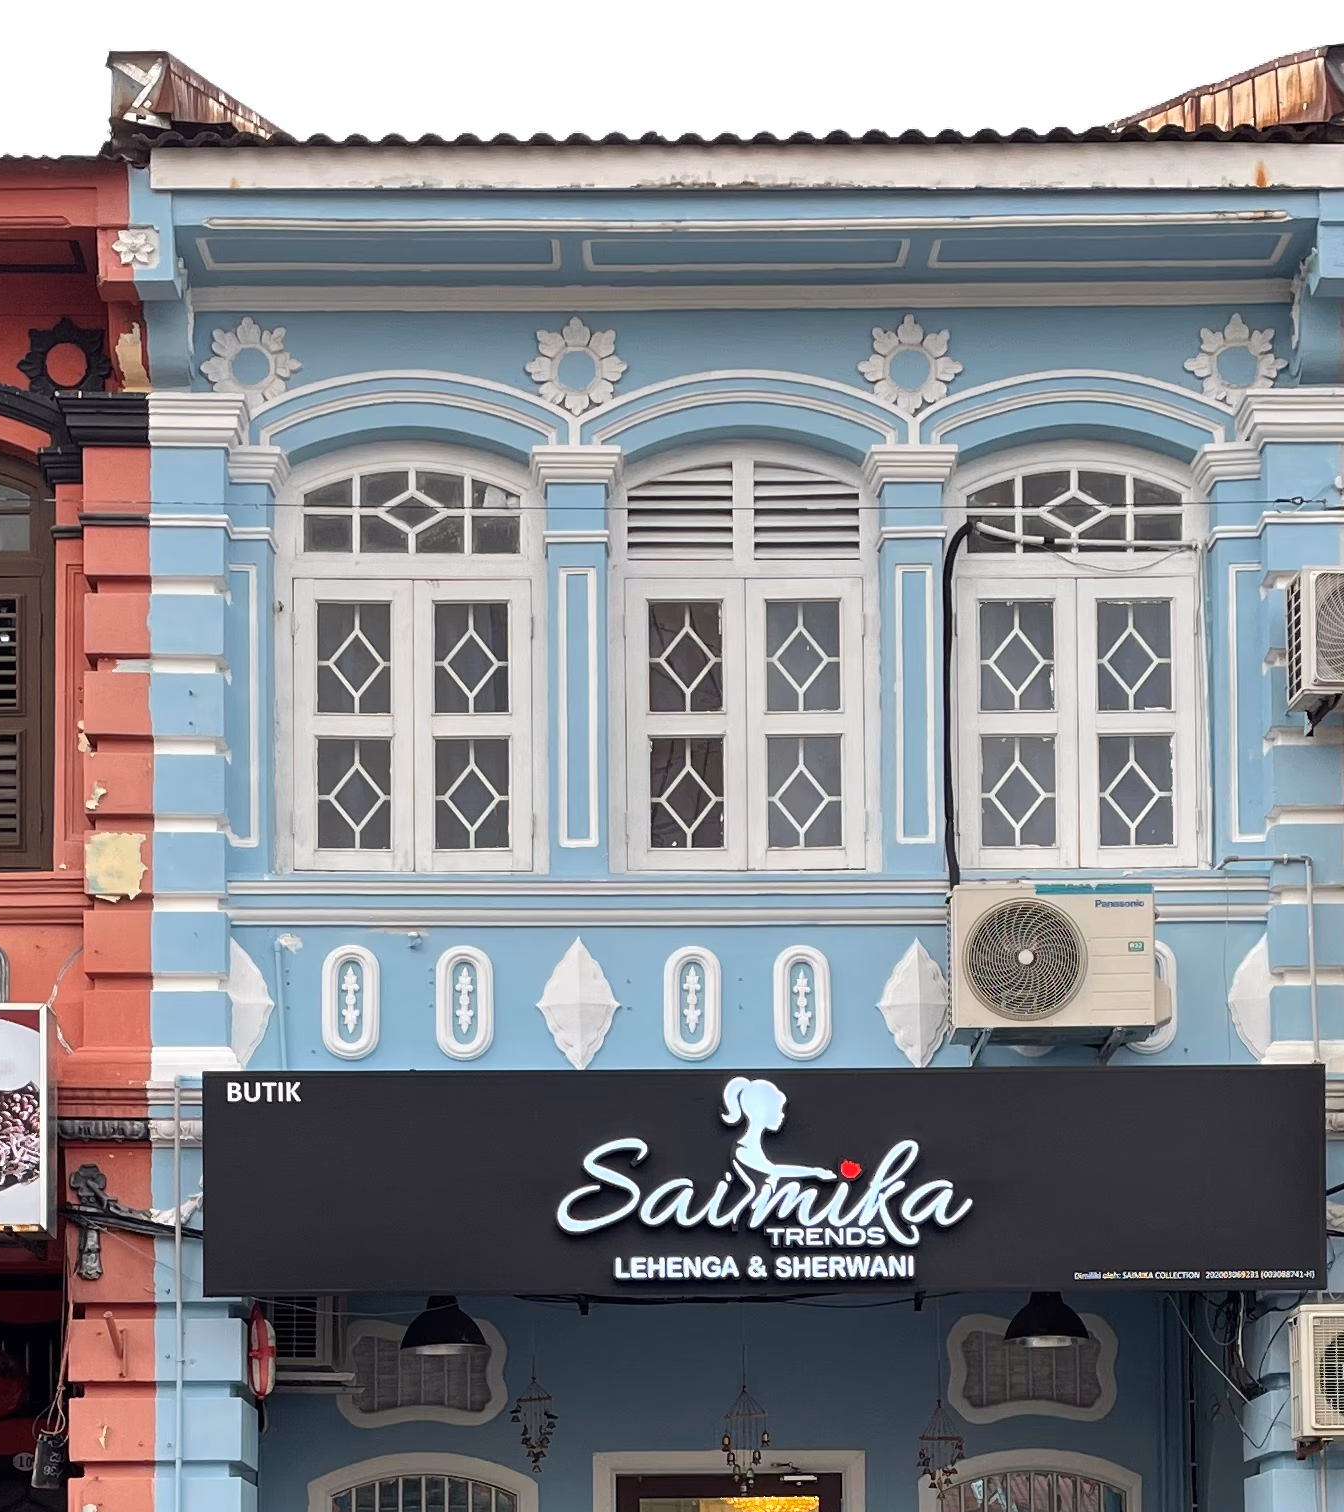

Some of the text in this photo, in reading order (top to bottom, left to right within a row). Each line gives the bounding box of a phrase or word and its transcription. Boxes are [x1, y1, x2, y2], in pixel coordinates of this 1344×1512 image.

[1095, 899, 1145, 908] Panasonic
[227, 1081, 302, 1102] BUTIK
[556, 1138, 973, 1246] Saimika
[766, 1226, 886, 1247] TRENDS
[614, 1255, 915, 1280] LEHENGA & SHERWANI
[1155, 1271, 1200, 1280] COLLECTION
